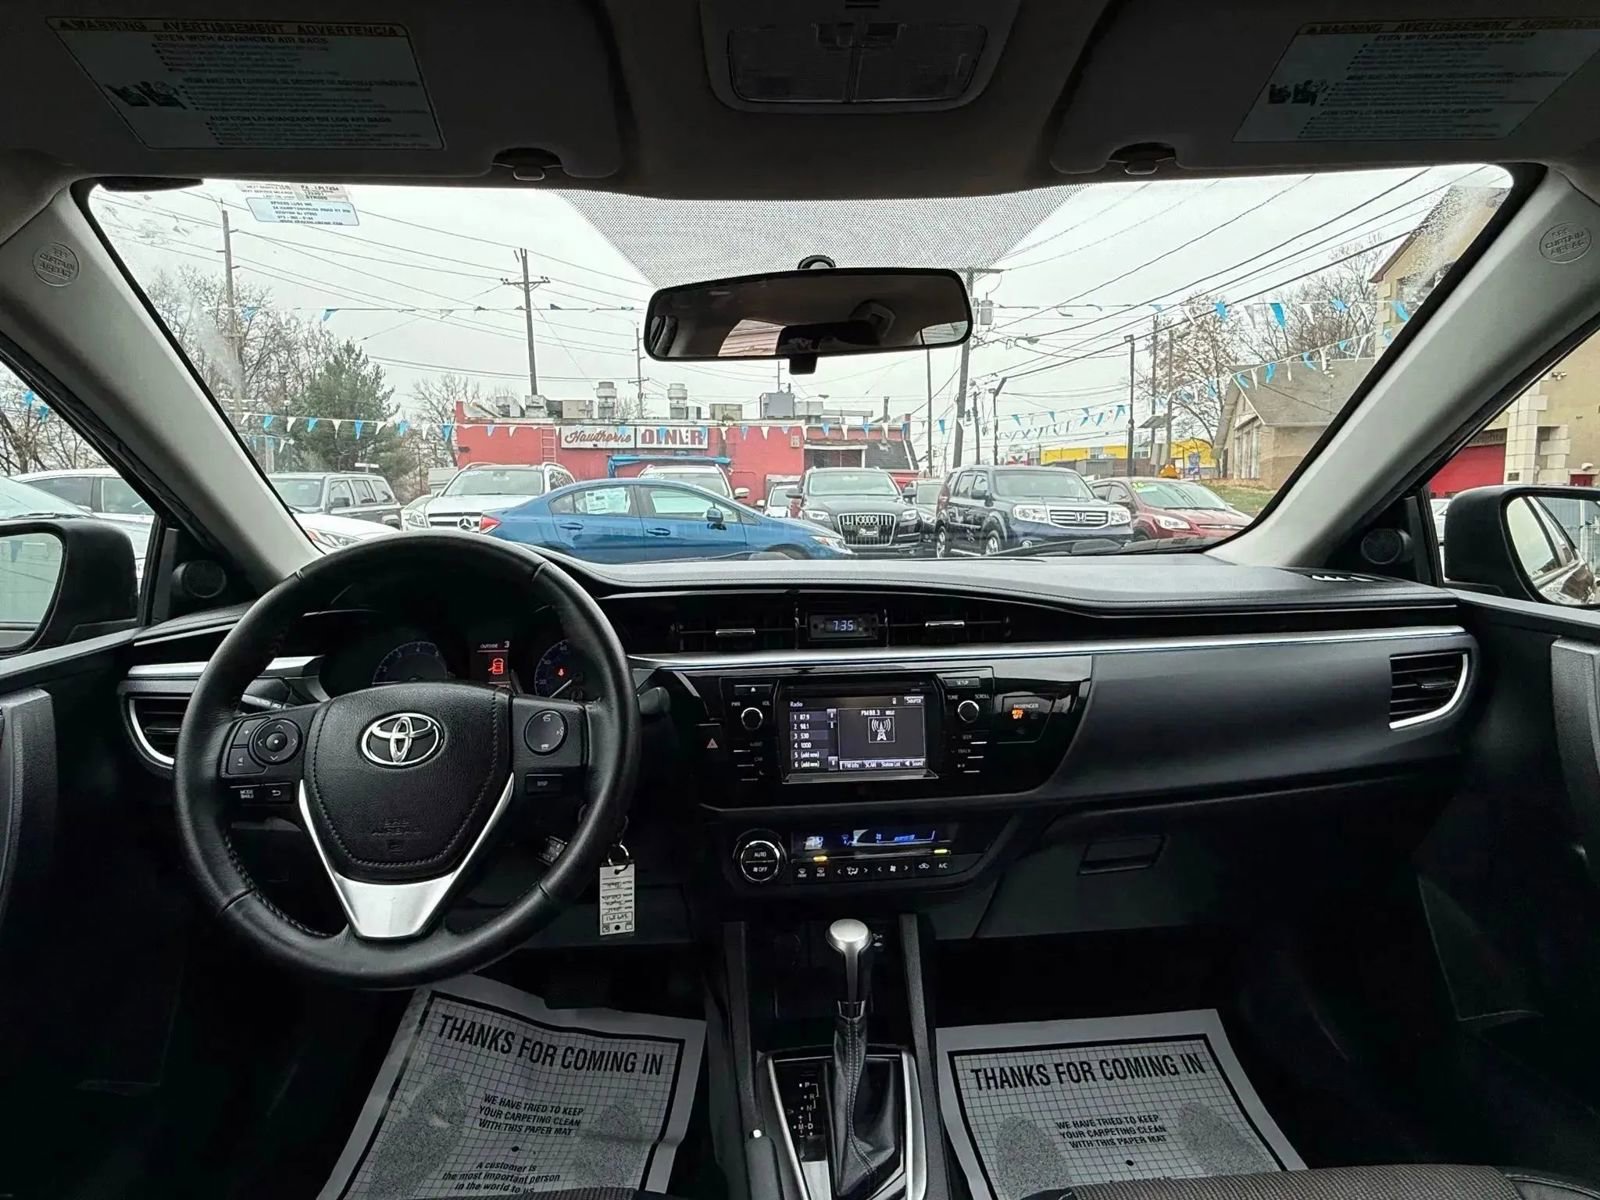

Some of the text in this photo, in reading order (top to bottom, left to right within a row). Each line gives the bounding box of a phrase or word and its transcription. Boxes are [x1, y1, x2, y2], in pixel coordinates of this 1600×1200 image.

[297, 24, 397, 36] ADVERTENCIA
[564, 430, 632, 444] Hawthorne
[438, 1014, 664, 1075] THANKS FOR COMING IN
[970, 1053, 1207, 1091] THANKS FOR COMING IN
[483, 1093, 584, 1116] WE HAVE TRIED TO KEEP
[479, 1105, 581, 1127] YOUR CARPETING CLEAN
[1055, 1114, 1159, 1129] WE HAVE TRIED TO KEEP
[478, 1118, 574, 1136] WITH THIS PAPER MAT
[807, 1122, 814, 1130] D
[1059, 1125, 1167, 1139] YOUR CARPETING CLEAN
[1069, 1134, 1168, 1149] WITH THIS PAPER MAT
[484, 1161, 527, 1173] customer
[528, 1164, 537, 1172] is
[442, 1172, 561, 1185] the most important person
[454, 1182, 464, 1190] in
[465, 1182, 482, 1191] the
[482, 1182, 510, 1192] world
[511, 1185, 520, 1193] to
